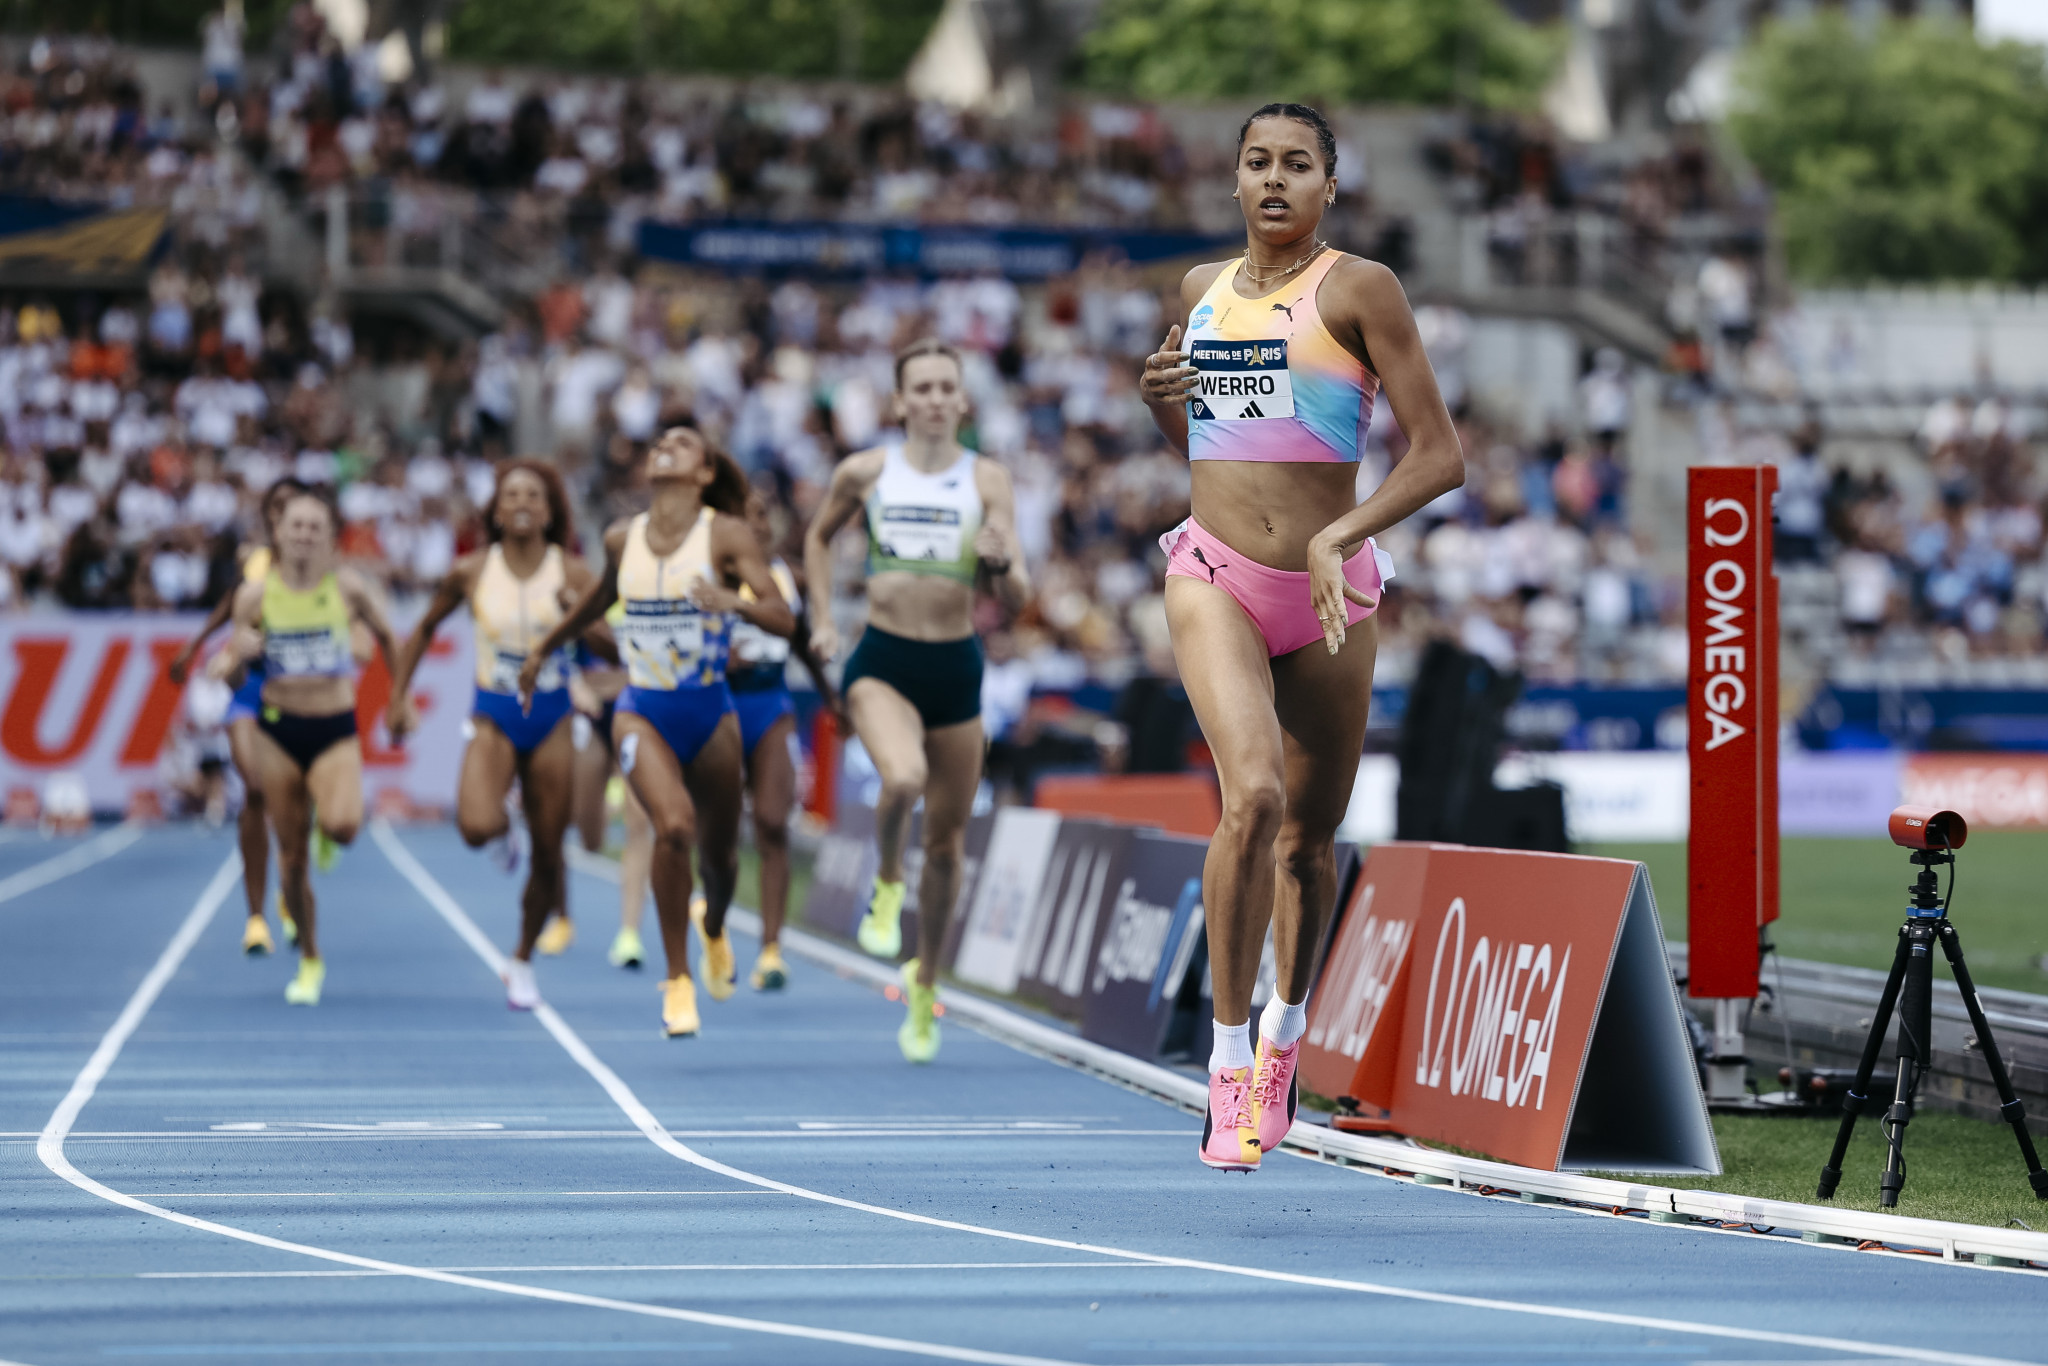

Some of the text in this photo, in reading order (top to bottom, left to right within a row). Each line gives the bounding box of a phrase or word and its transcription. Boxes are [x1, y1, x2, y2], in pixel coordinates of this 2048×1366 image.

[1193, 346, 1282, 365] MEETING DE PARIS
[1200, 375, 1275, 396] WERRO
[1704, 559, 1746, 751] OMEGA
[1450, 936, 1572, 1111] OMEGA
